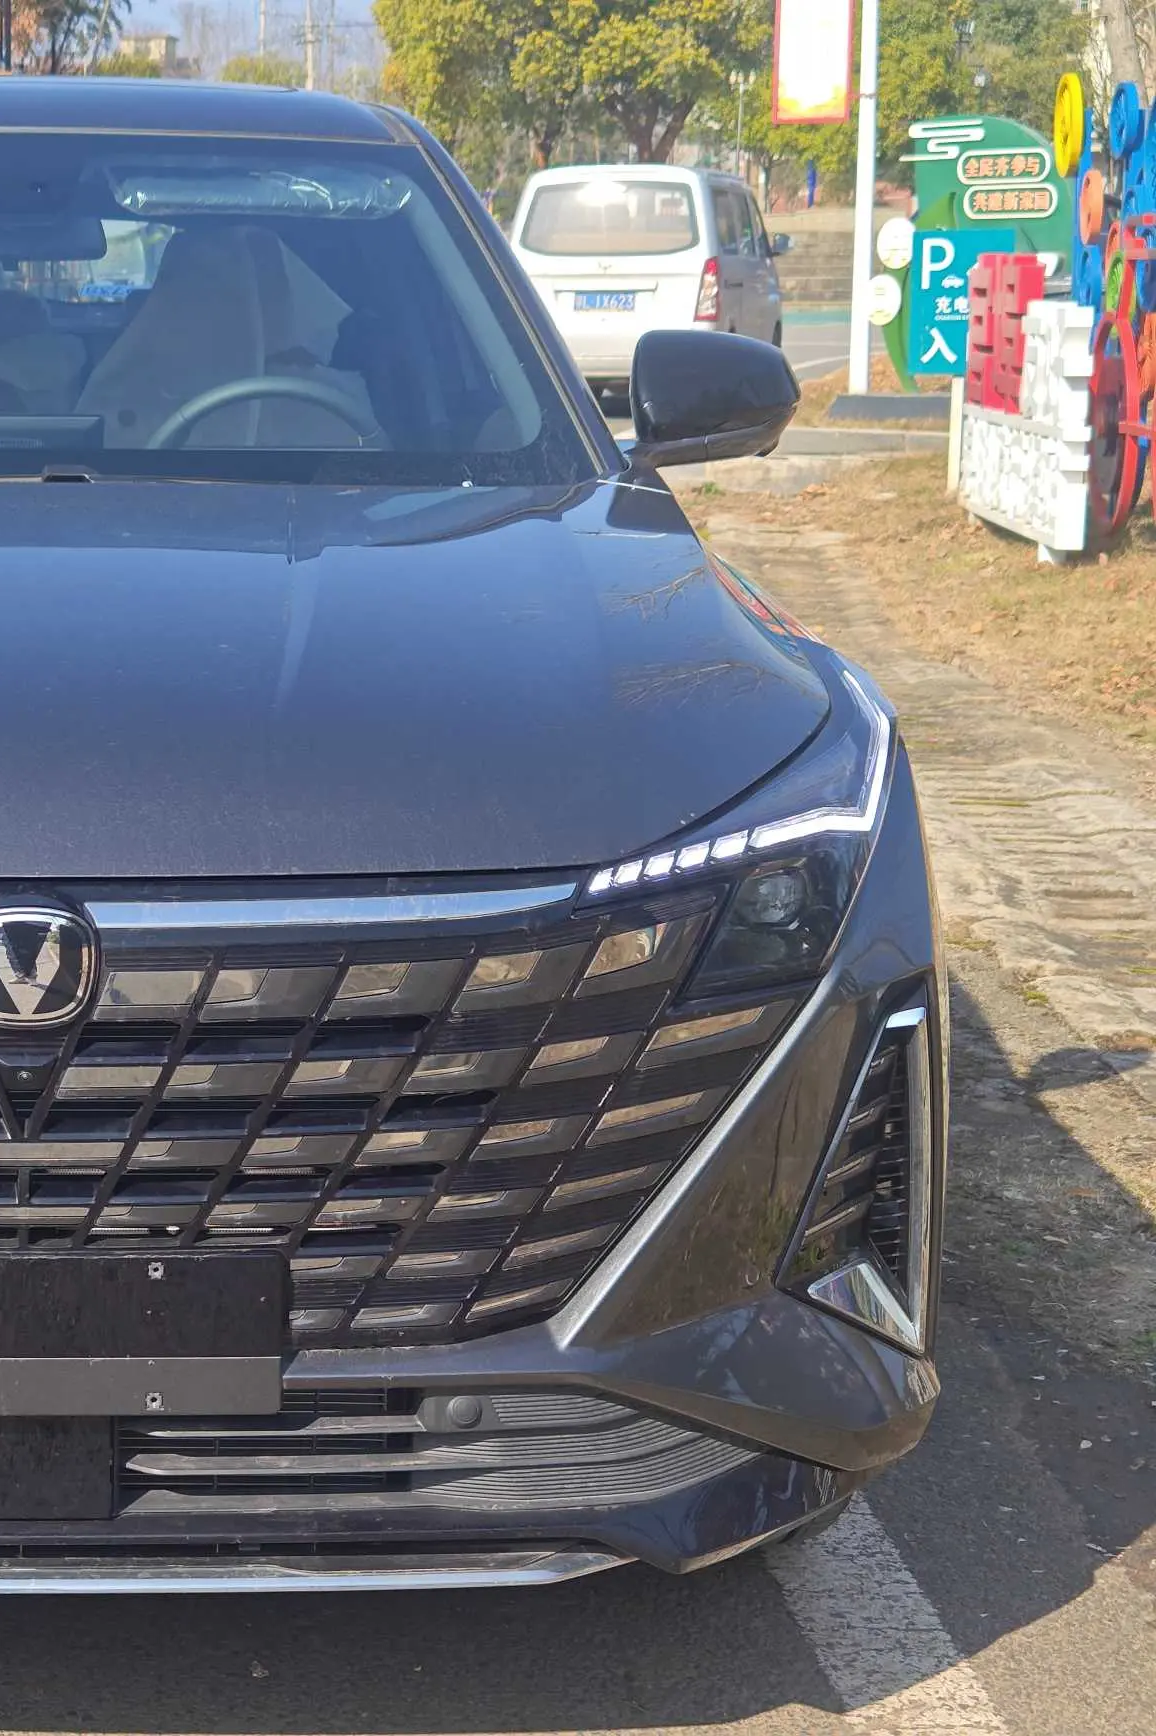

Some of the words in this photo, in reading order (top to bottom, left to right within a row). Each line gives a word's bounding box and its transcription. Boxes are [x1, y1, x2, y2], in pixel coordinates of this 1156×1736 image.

[964, 155, 1041, 177] 全民齐参与
[920, 237, 955, 290] P
[934, 295, 970, 314] 充电
[920, 327, 970, 365] 入
